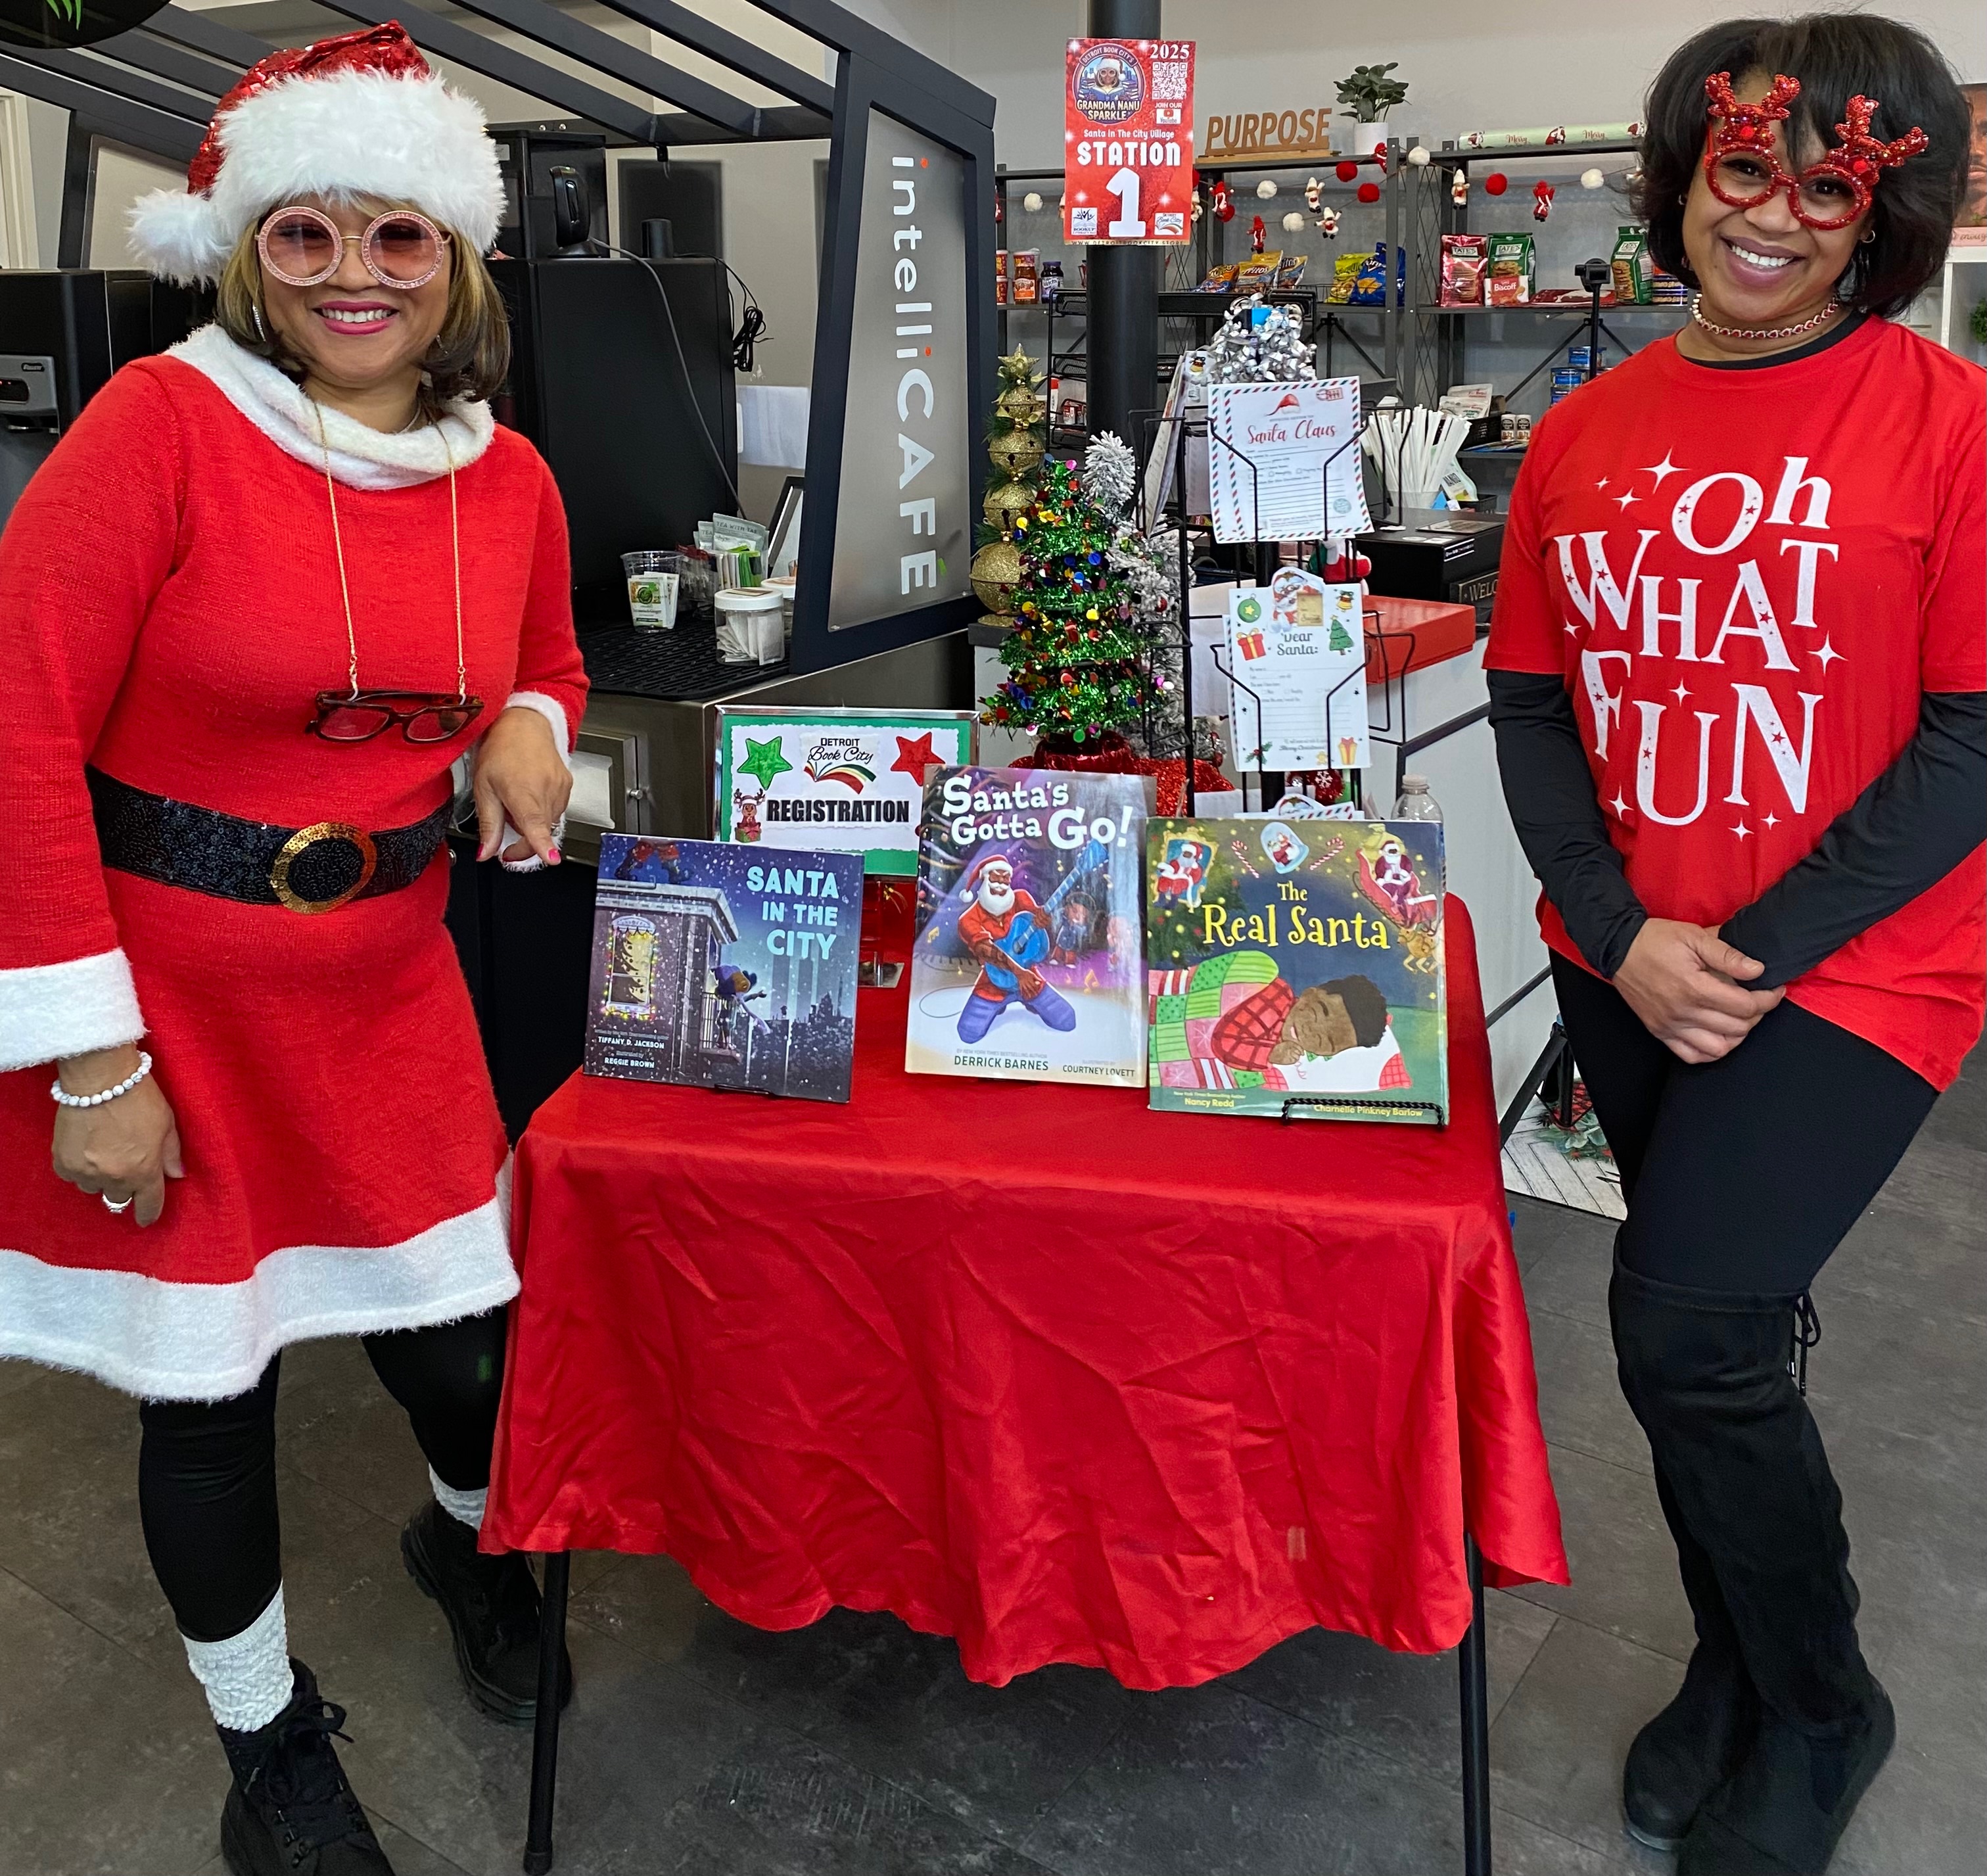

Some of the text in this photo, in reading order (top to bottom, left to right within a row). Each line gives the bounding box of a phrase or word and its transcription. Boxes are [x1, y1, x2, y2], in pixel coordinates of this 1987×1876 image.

[1082, 47, 1103, 63] DETROIT
[1119, 49, 1135, 63] CITY'S
[1150, 44, 1190, 59] 2025
[1077, 100, 1115, 110] GRANDMA
[1088, 110, 1127, 120] SPARKLE
[1133, 129, 1148, 140] City
[1150, 130, 1175, 140] Village
[1206, 108, 1332, 155] PURPOSE
[1506, 135, 1528, 144] Merry
[1582, 130, 1605, 139] Merry
[1077, 141, 1181, 166] STATION
[1106, 167, 1146, 237] 1
[1960, 233, 1986, 243] enoug
[1282, 258, 1297, 269] itos
[1494, 282, 1516, 291] Biscoff
[1248, 419, 1336, 444] Santa Claus
[1672, 456, 1832, 555] Oh
[1469, 579, 1499, 601] WELC
[1553, 529, 1839, 672] WHAT
[1277, 643, 1319, 656] Santa:
[820, 738, 860, 747] DETROIT
[1581, 649, 1825, 826] FUN
[807, 745, 875, 764] Book City
[941, 774, 1069, 817] Santa's
[766, 799, 910, 823] REGISTRATION
[950, 805, 1133, 850] Gotta Go!
[746, 865, 839, 899] SANTA
[1277, 881, 1308, 902] The
[762, 901, 839, 927] IN THE
[1202, 903, 1391, 949] Real Santa
[766, 929, 837, 960] CITY
[598, 1036, 625, 1045] TIFFANY
[634, 1040, 665, 1049] JACKSON
[604, 1057, 655, 1069] REGGIE BROWN
[954, 1056, 1049, 1071] DERRICK BARNES
[1062, 1065, 1135, 1077] COURTNEY LOVETT
[1184, 1097, 1235, 1108] Nancy Redd
[1357, 1106, 1390, 1117] Pinkney
[1393, 1108, 1423, 1117] Barlow
